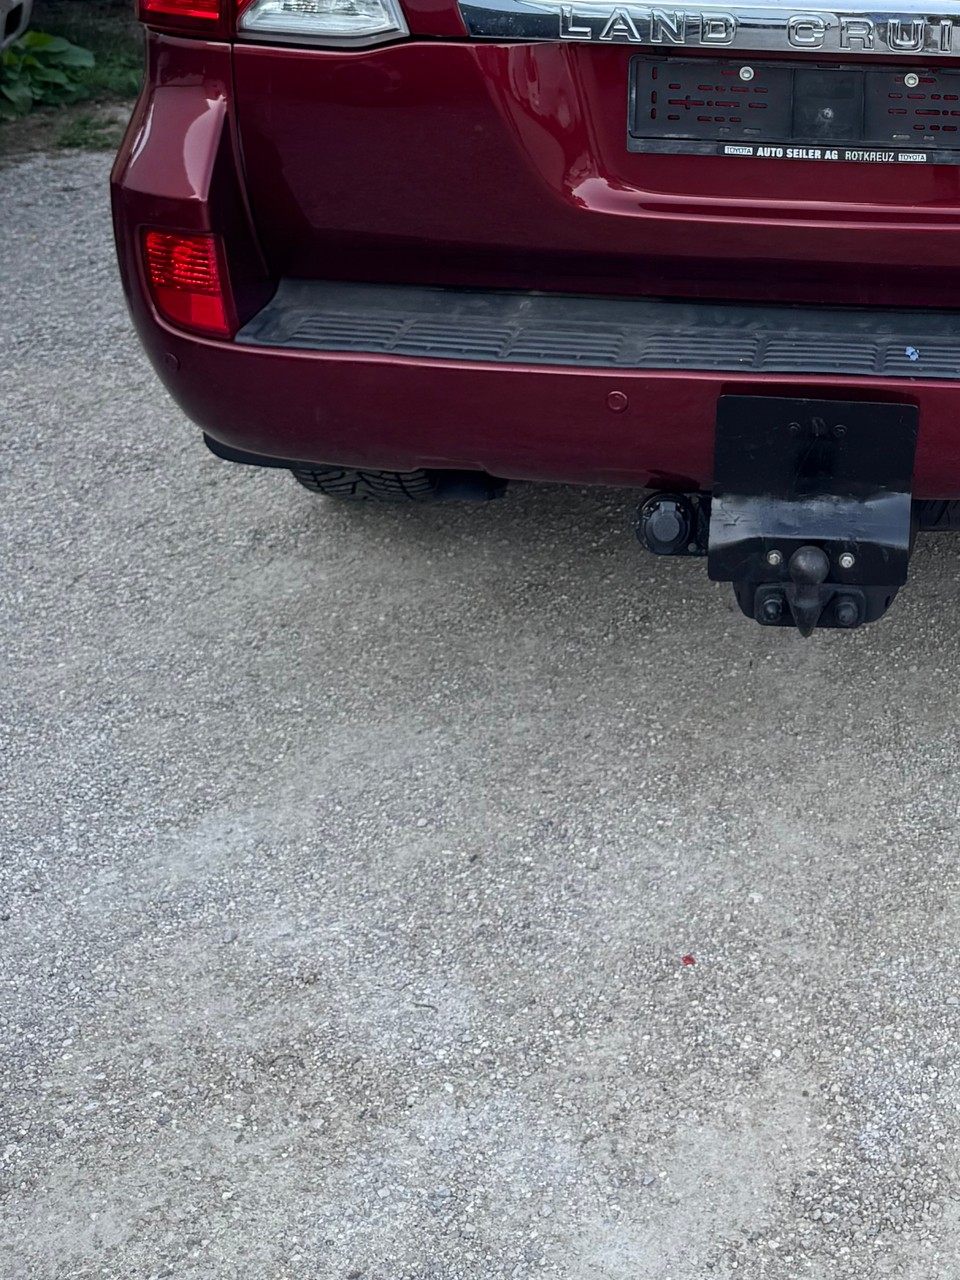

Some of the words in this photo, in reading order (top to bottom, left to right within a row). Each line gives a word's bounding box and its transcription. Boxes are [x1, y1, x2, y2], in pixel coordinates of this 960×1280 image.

[558, 3, 738, 46] LAND
[756, 147, 784, 157] AUTO
[786, 148, 821, 159] SEILER
[824, 150, 839, 160] AG
[845, 151, 895, 162] ROTKREUZ
[899, 153, 927, 162] TOYOTA
